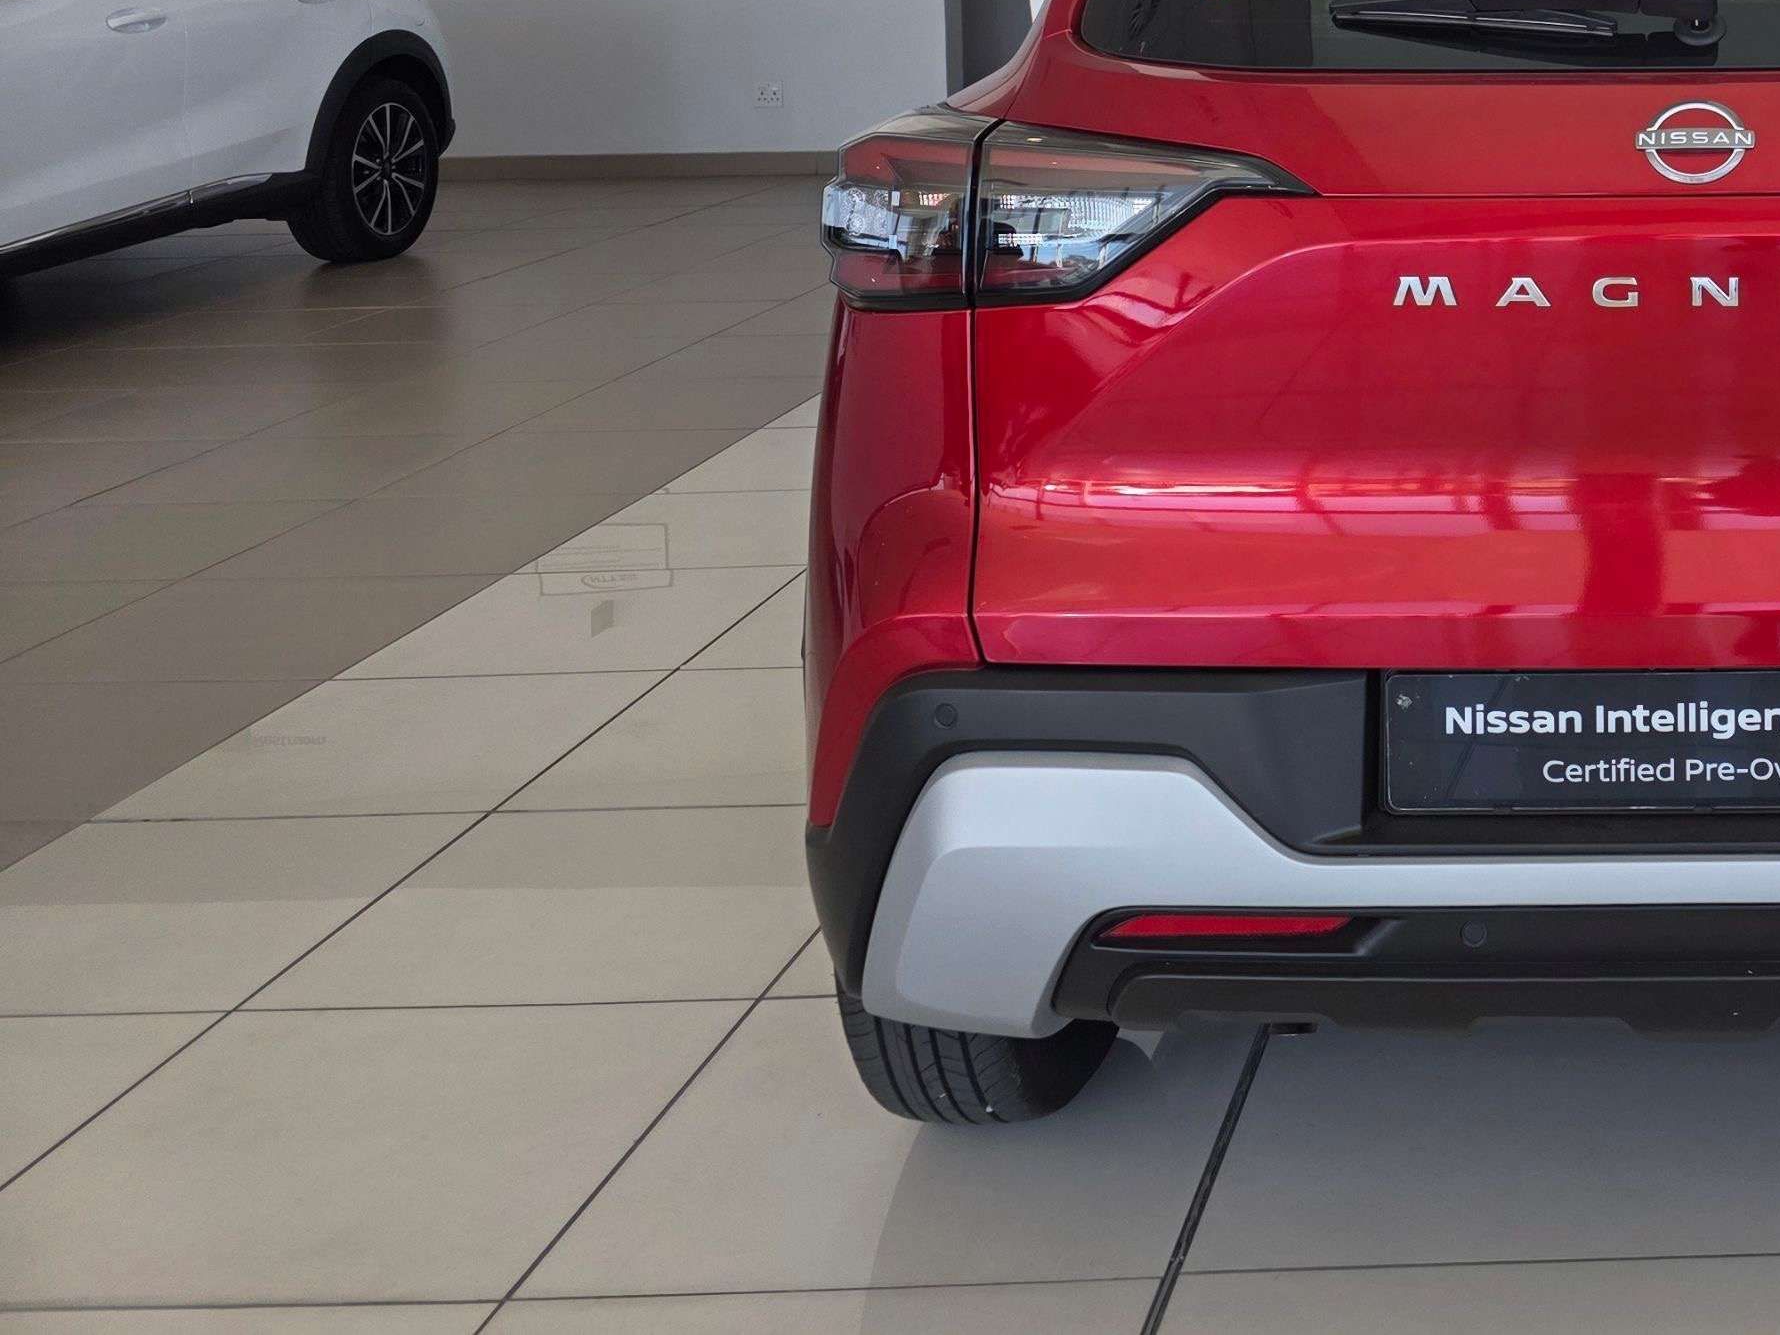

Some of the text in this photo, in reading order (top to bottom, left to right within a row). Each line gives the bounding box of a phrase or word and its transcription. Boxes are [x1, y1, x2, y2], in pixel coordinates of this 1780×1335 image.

[1638, 130, 1753, 145] NISSAN
[1445, 705, 1583, 735] Nissan
[1542, 757, 1675, 784] Certified
